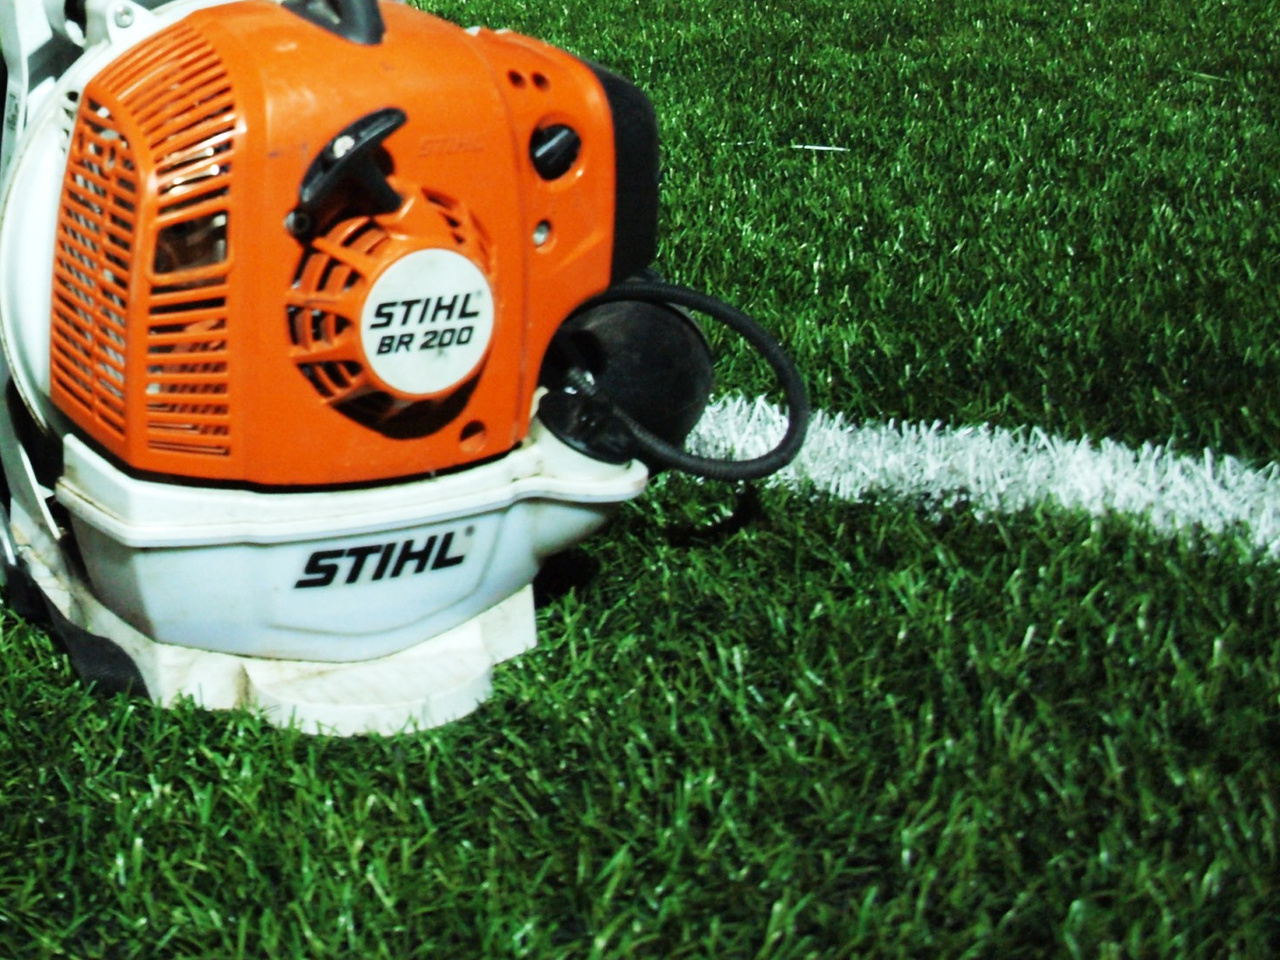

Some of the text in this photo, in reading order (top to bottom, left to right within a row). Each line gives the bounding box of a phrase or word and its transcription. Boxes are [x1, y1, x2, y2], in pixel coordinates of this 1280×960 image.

[369, 292, 480, 330] STIHL
[376, 326, 474, 355] BR 200
[294, 531, 466, 589] STIHL
